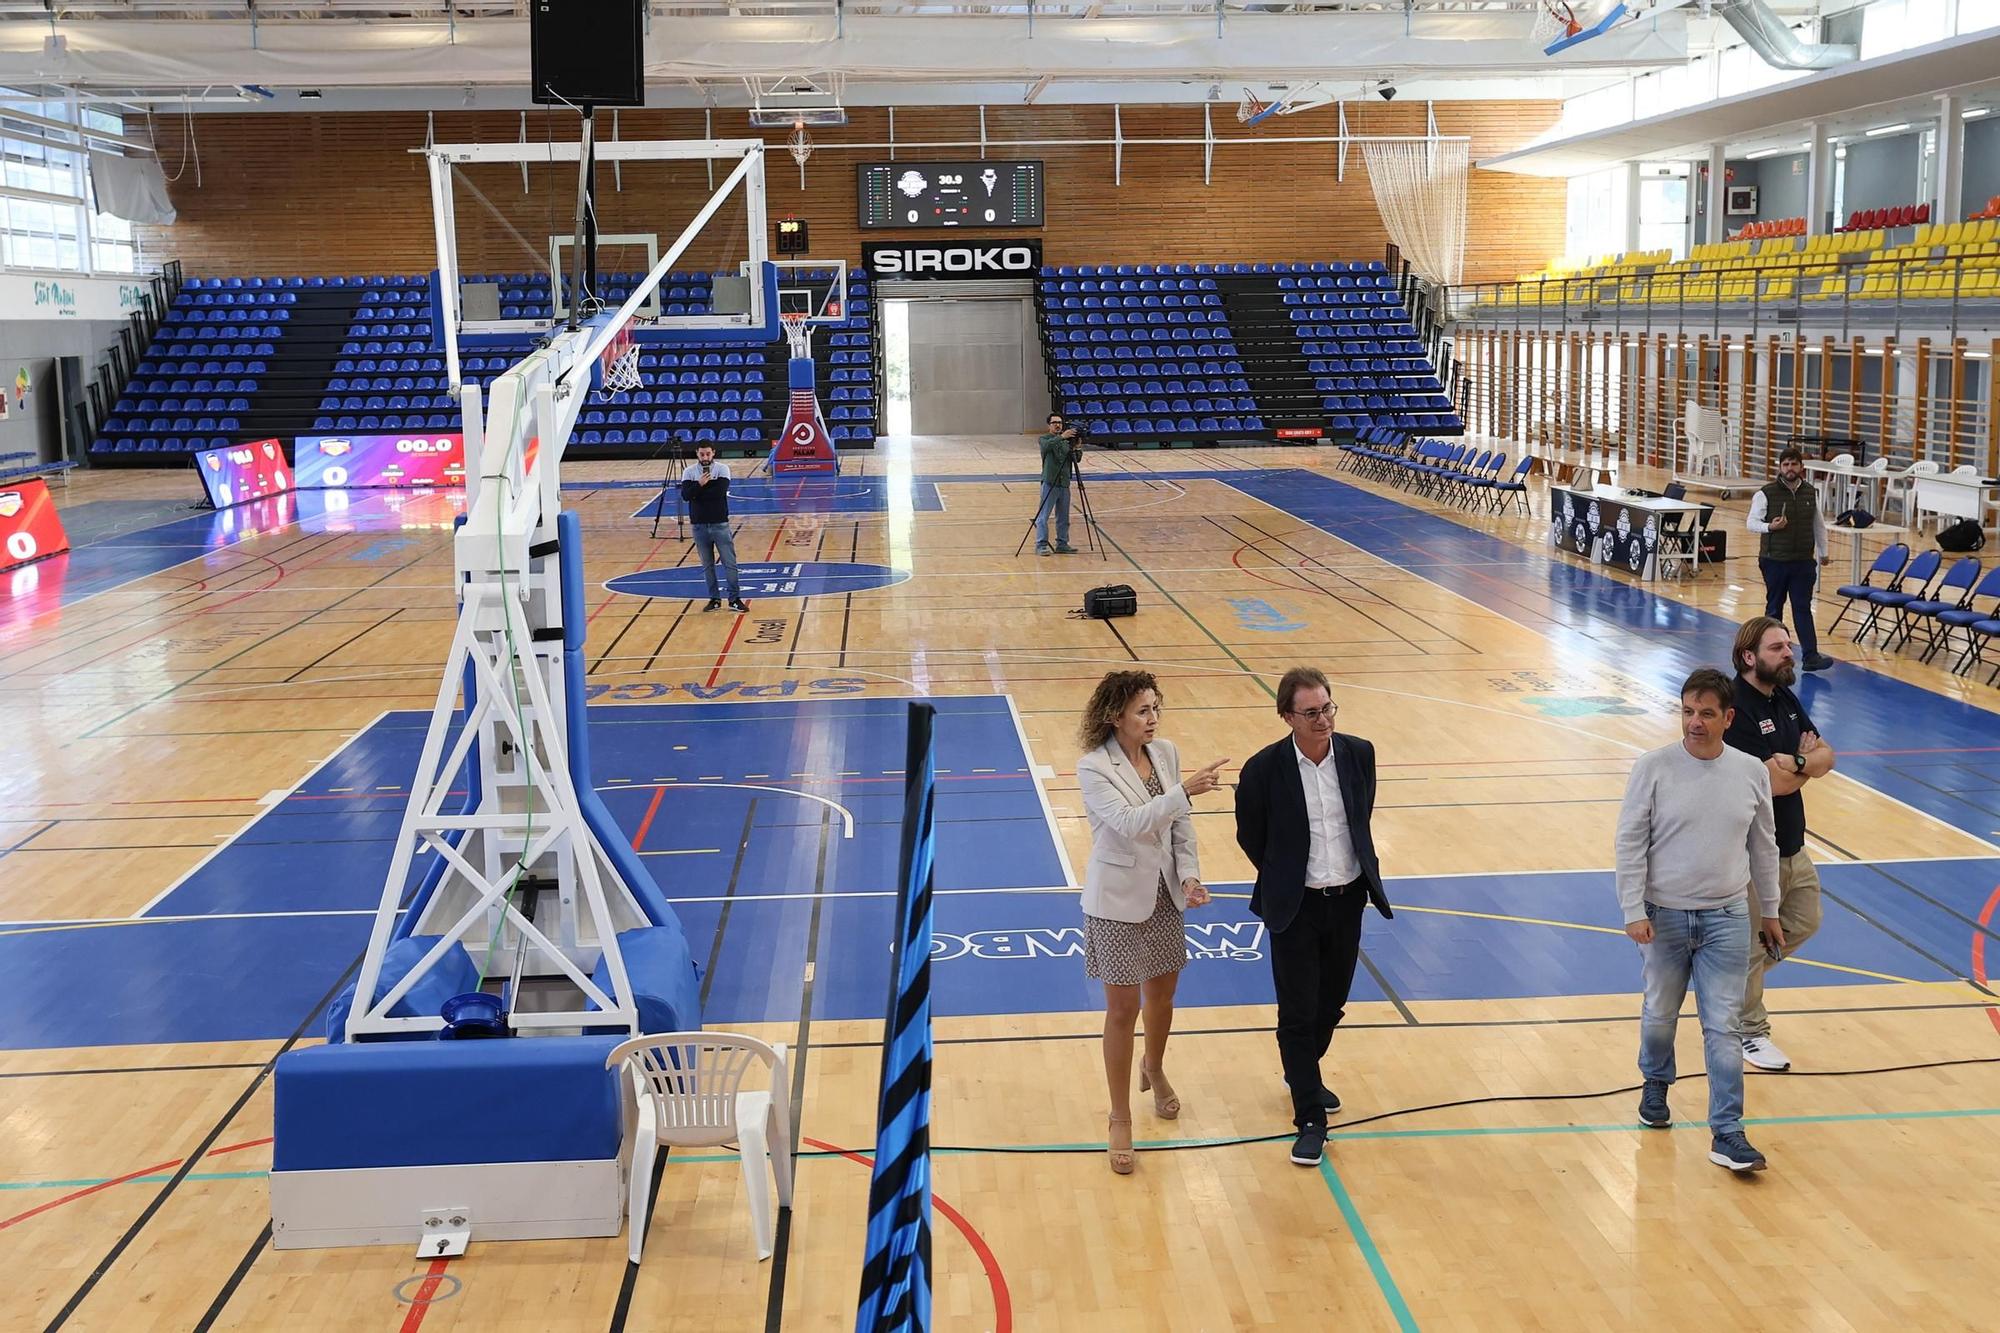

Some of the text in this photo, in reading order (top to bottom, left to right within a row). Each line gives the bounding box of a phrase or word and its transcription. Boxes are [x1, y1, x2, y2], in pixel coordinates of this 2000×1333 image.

[938, 175, 963, 185] 30.9
[907, 209, 919, 223] 0
[984, 208, 996, 222] 0
[873, 247, 1032, 273] SIROKO
[396, 438, 452, 453] 00.0
[322, 466, 348, 486] 0
[7, 531, 37, 559] 0
